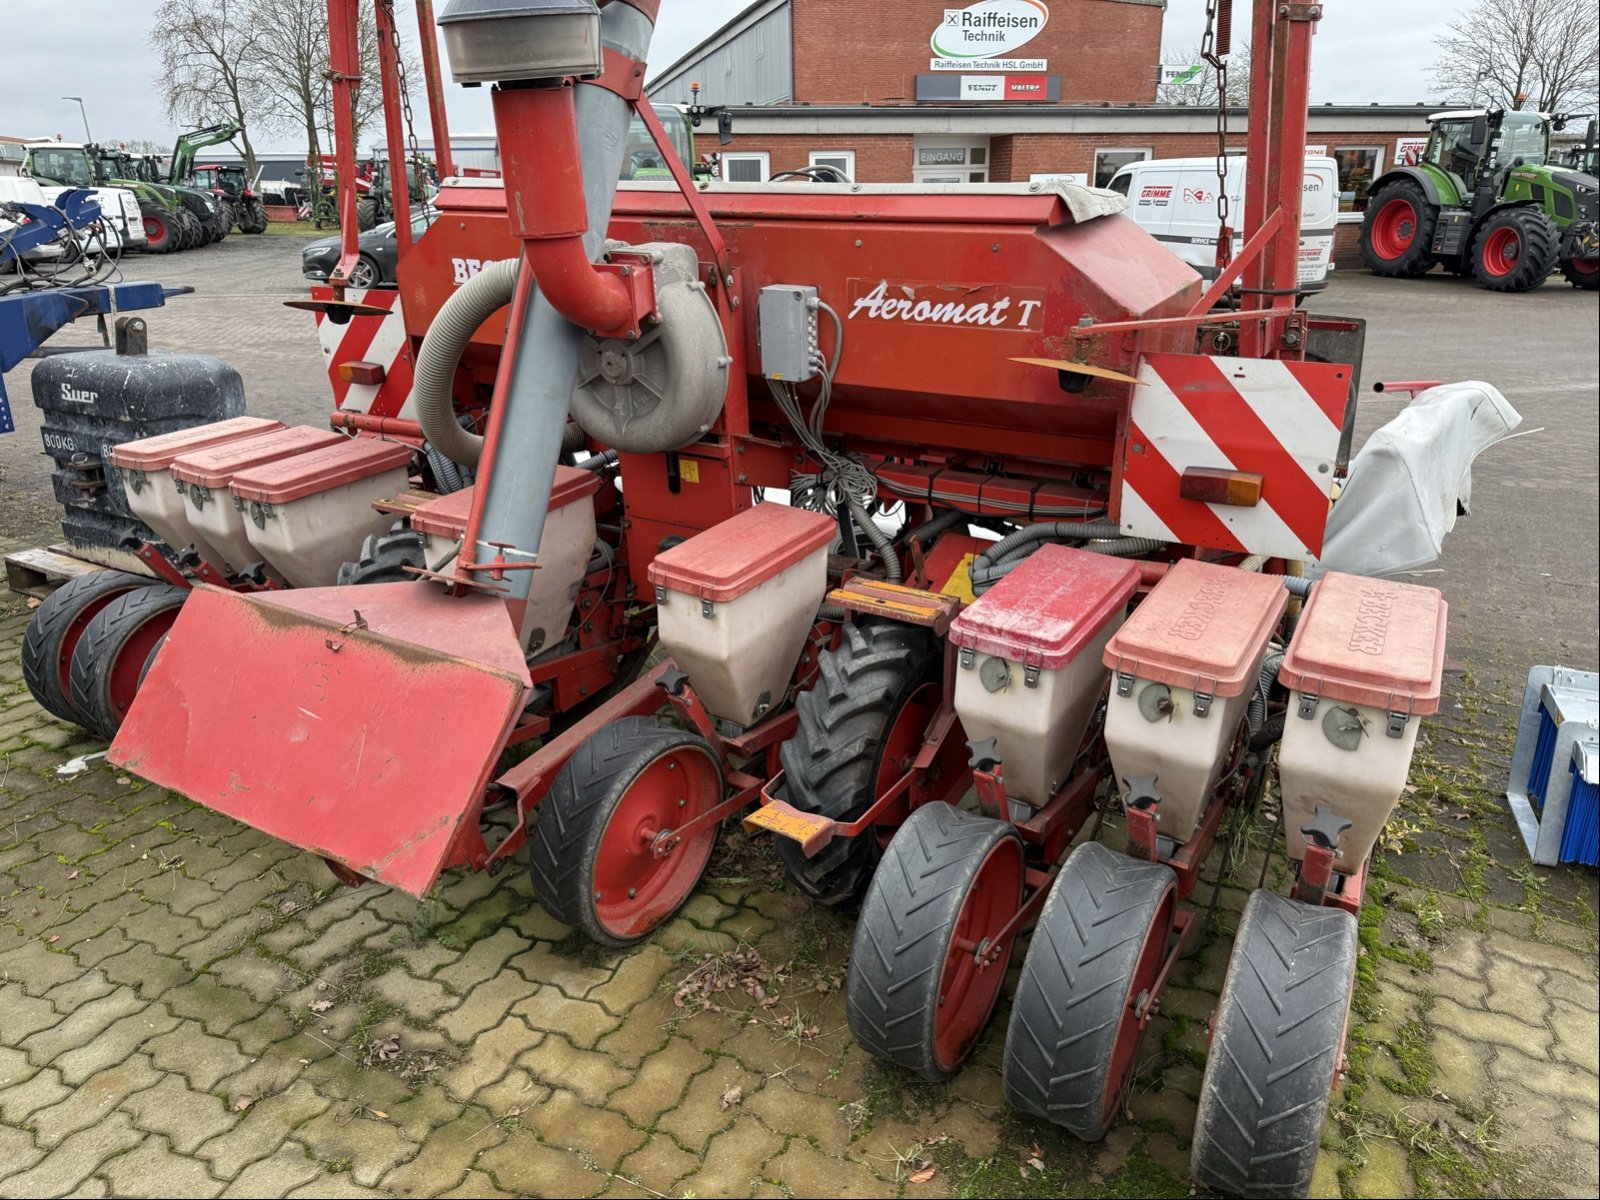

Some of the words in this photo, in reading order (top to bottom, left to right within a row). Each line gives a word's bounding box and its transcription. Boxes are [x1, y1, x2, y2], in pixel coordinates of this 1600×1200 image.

[962, 11, 1038, 28] Raiffeisen
[962, 29, 1006, 42] Technik
[934, 60, 971, 69] Raiffeisen
[973, 60, 1001, 69] Technik
[1002, 61, 1018, 69] HSL
[1019, 61, 1044, 69] GmbH
[1165, 70, 1194, 79] FENDT
[967, 84, 998, 92] FENDT
[1010, 84, 1041, 92] VALTRA
[920, 152, 964, 162] EINGANG
[1141, 189, 1172, 198] GRIMME
[1190, 236, 1210, 245] SERVICE
[847, 278, 1011, 327] Aeromat
[1018, 300, 1042, 327] T
[61, 382, 99, 404] Suer
[44, 433, 75, 452] 800KG
[1167, 585, 1229, 641] BECKER
[1347, 598, 1393, 656] BECKER
